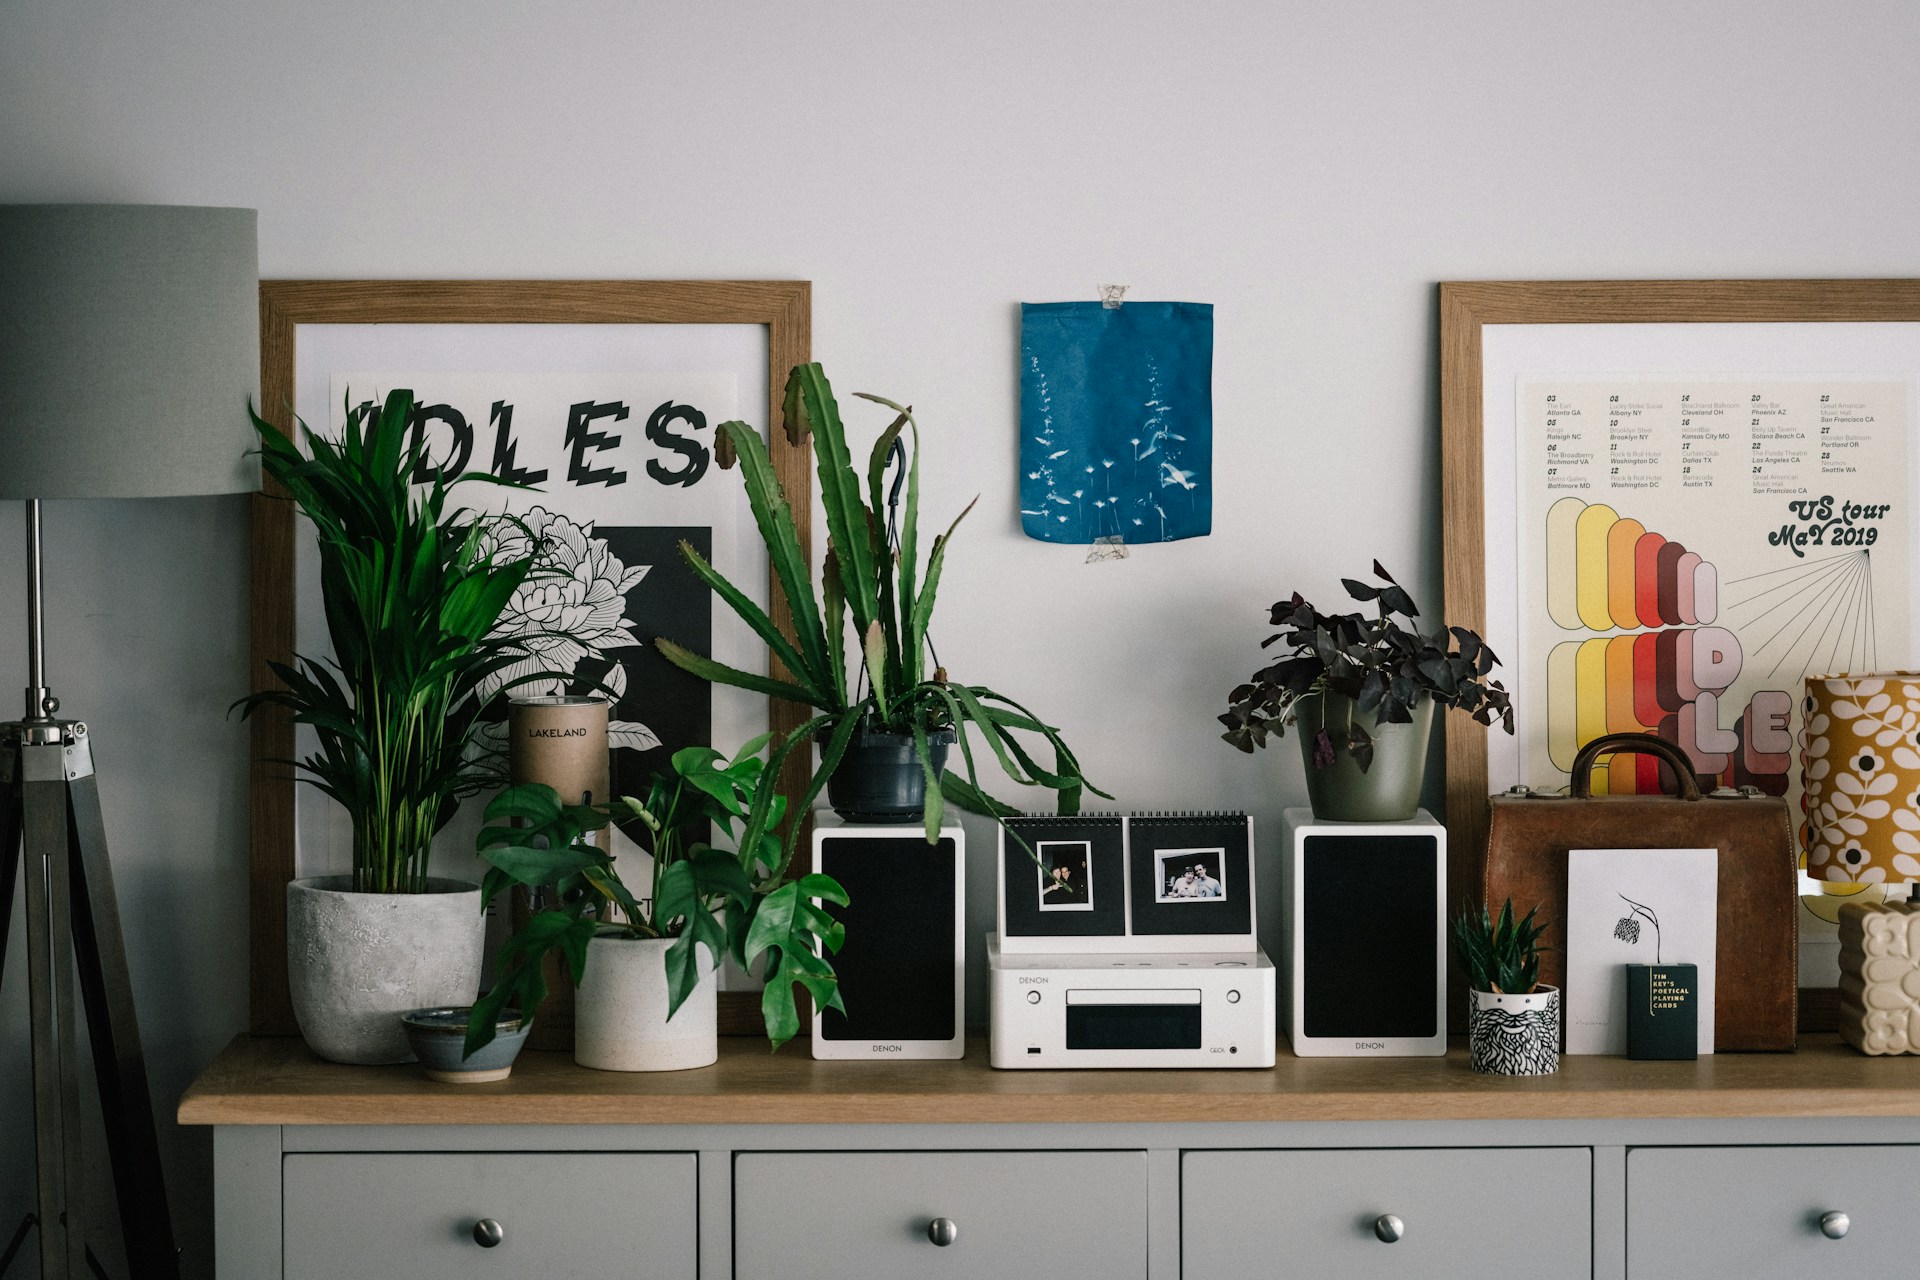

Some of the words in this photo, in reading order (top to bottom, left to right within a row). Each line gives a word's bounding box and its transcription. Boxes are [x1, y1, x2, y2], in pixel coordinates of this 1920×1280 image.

[1789, 495, 1834, 520] US
[1842, 500, 1890, 526] tour
[1831, 527, 1878, 545] 2019
[529, 728, 587, 738] LAKELAND
